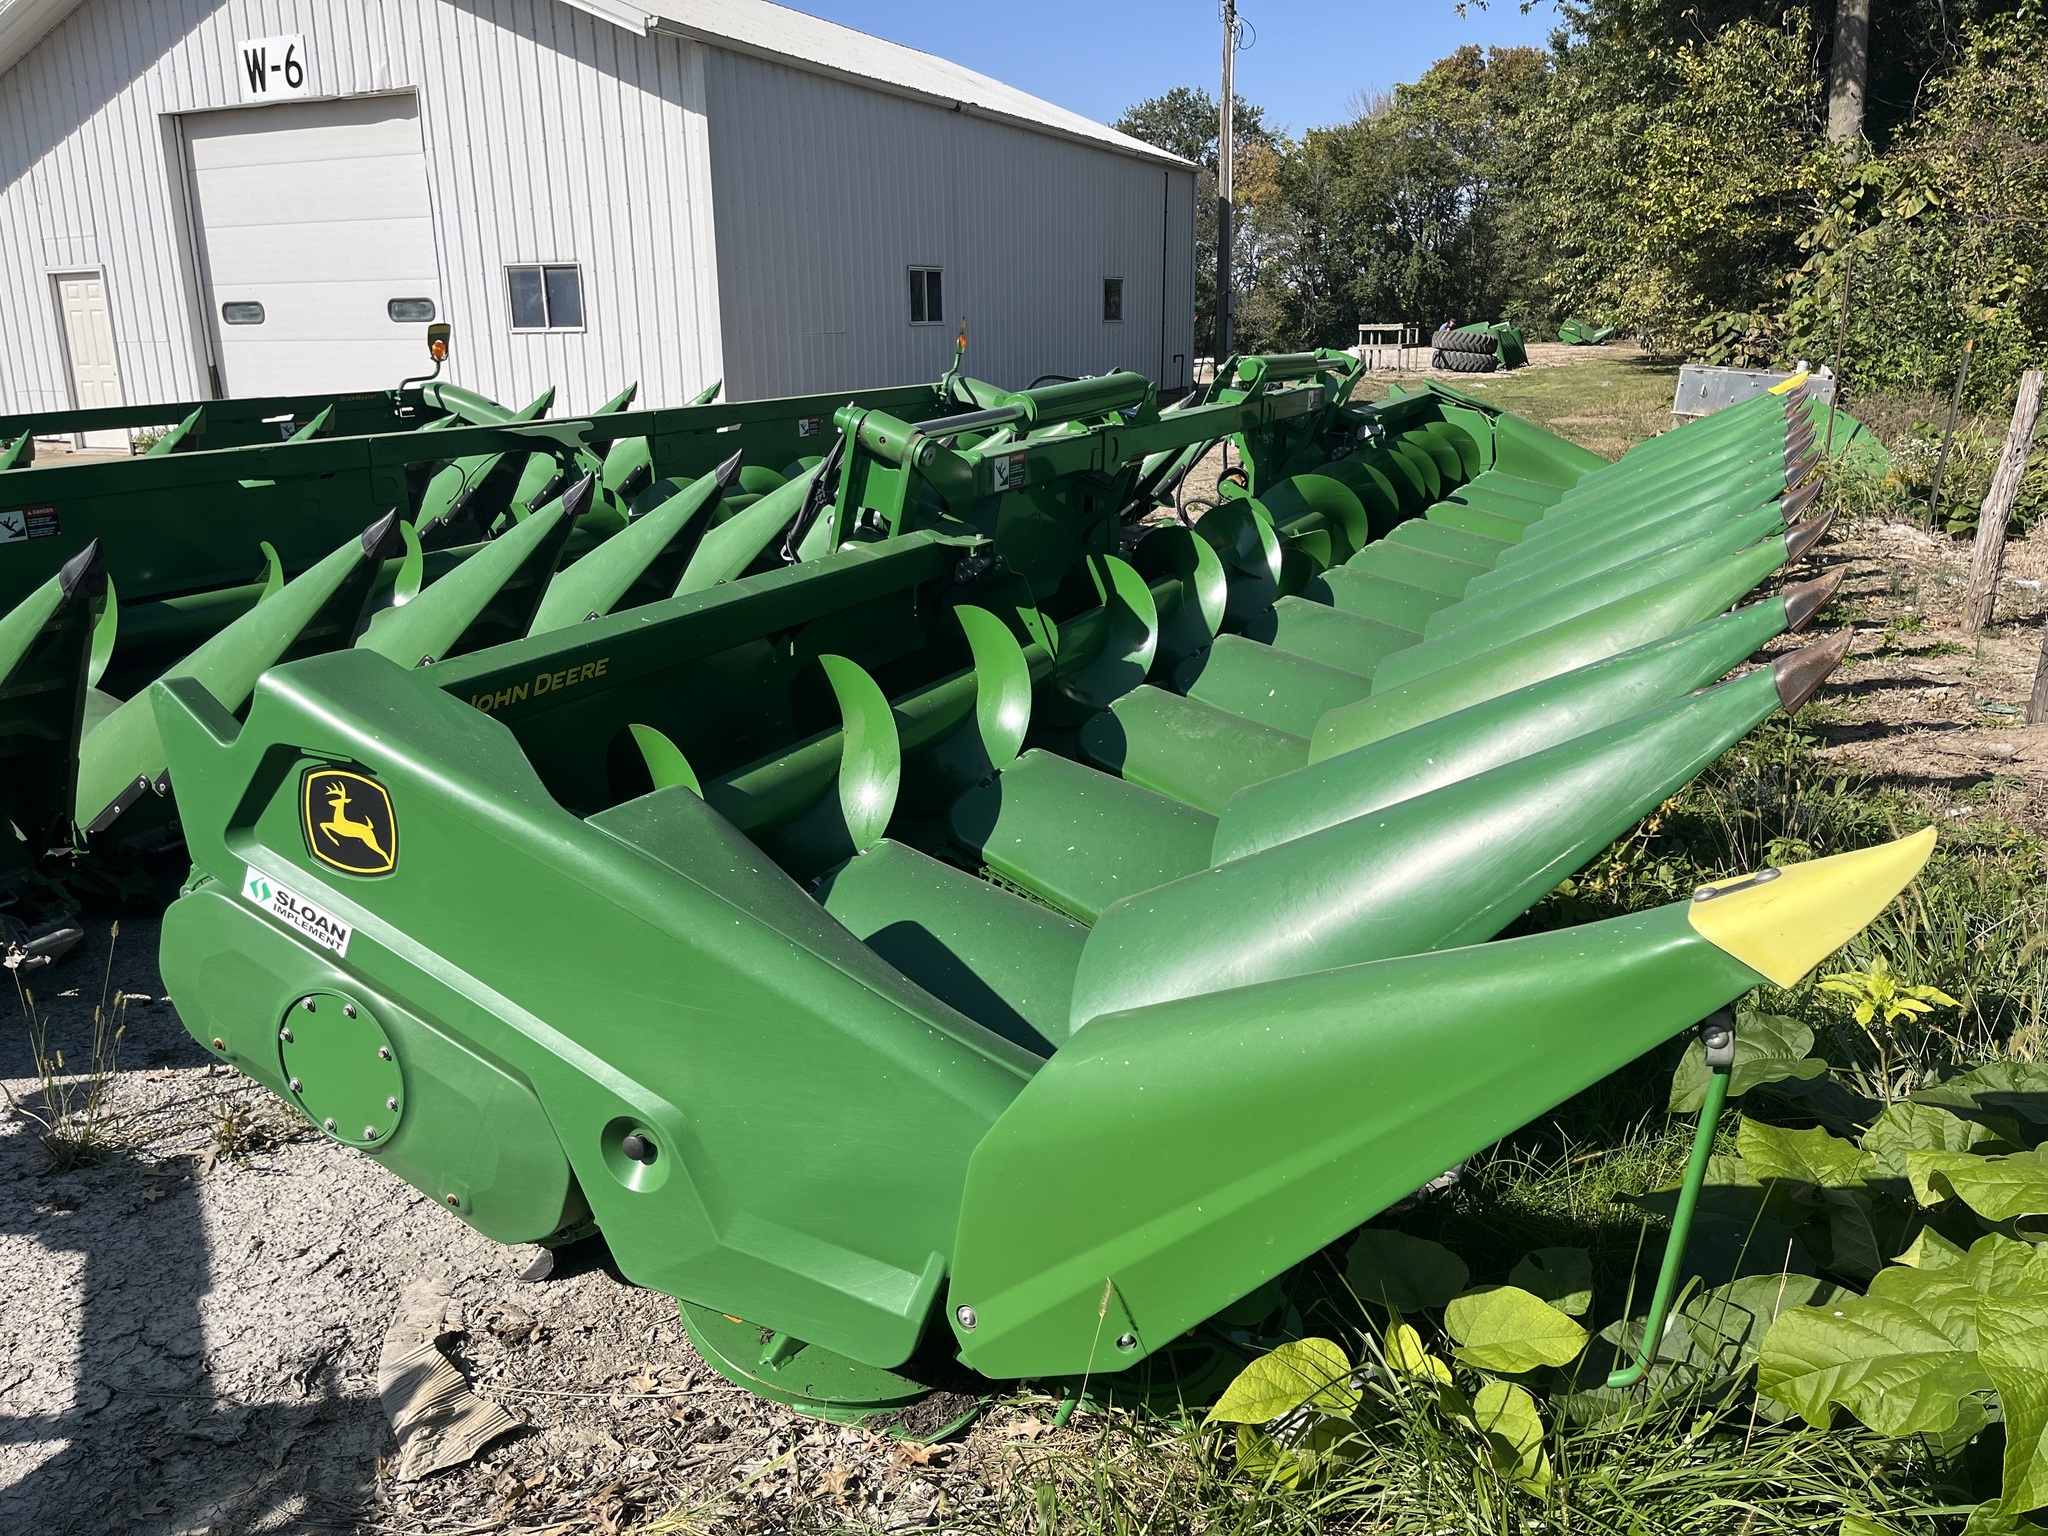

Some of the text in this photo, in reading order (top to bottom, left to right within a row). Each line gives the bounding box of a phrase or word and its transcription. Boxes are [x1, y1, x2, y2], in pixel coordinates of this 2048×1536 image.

[243, 43, 304, 94] W-6
[32, 507, 54, 515] DANGER
[533, 657, 610, 697] DEERE
[273, 903, 344, 951] IMPLEMENT
[275, 890, 347, 943] SLOAN
